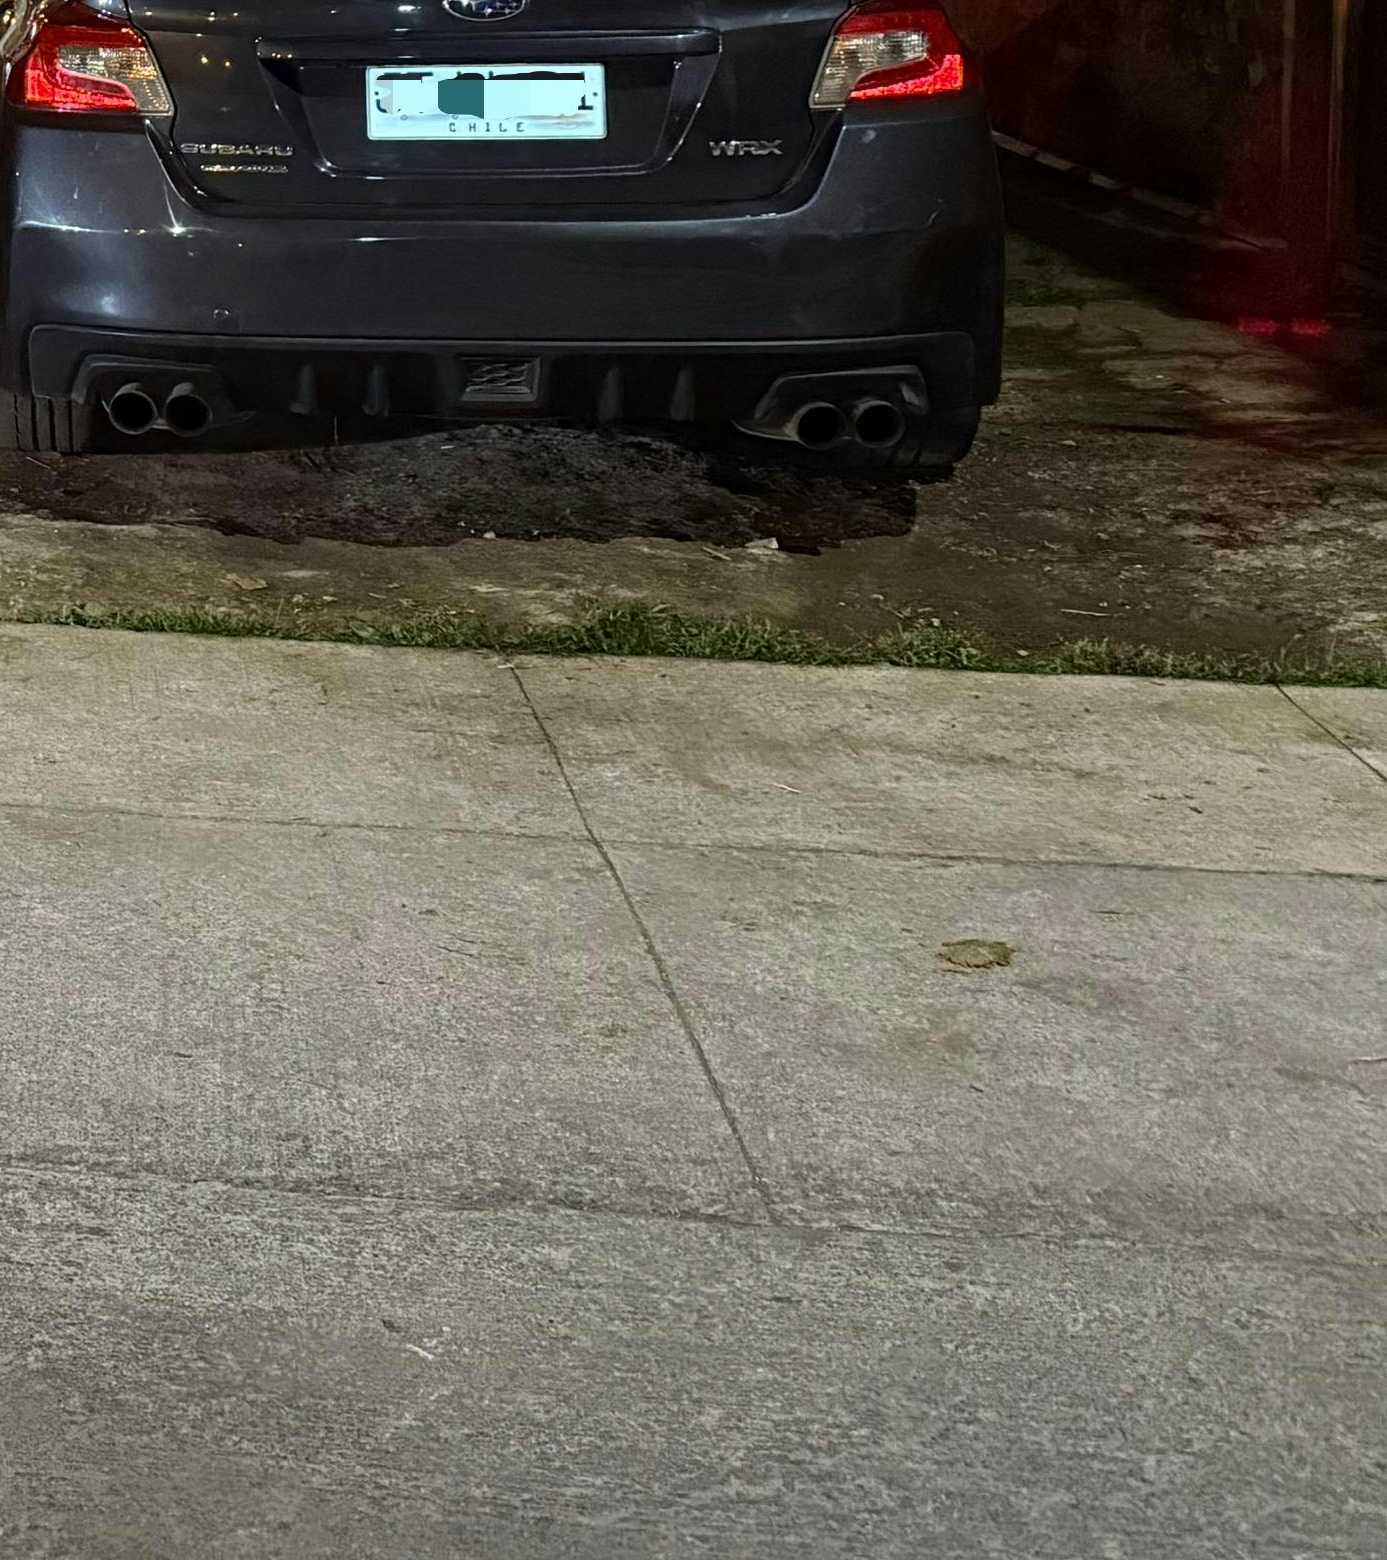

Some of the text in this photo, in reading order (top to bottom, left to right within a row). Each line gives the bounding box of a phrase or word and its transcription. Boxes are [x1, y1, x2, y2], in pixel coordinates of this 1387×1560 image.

[448, 121, 527, 133] CHILE
[180, 143, 293, 156] SUBARU
[709, 140, 782, 156] WRX
